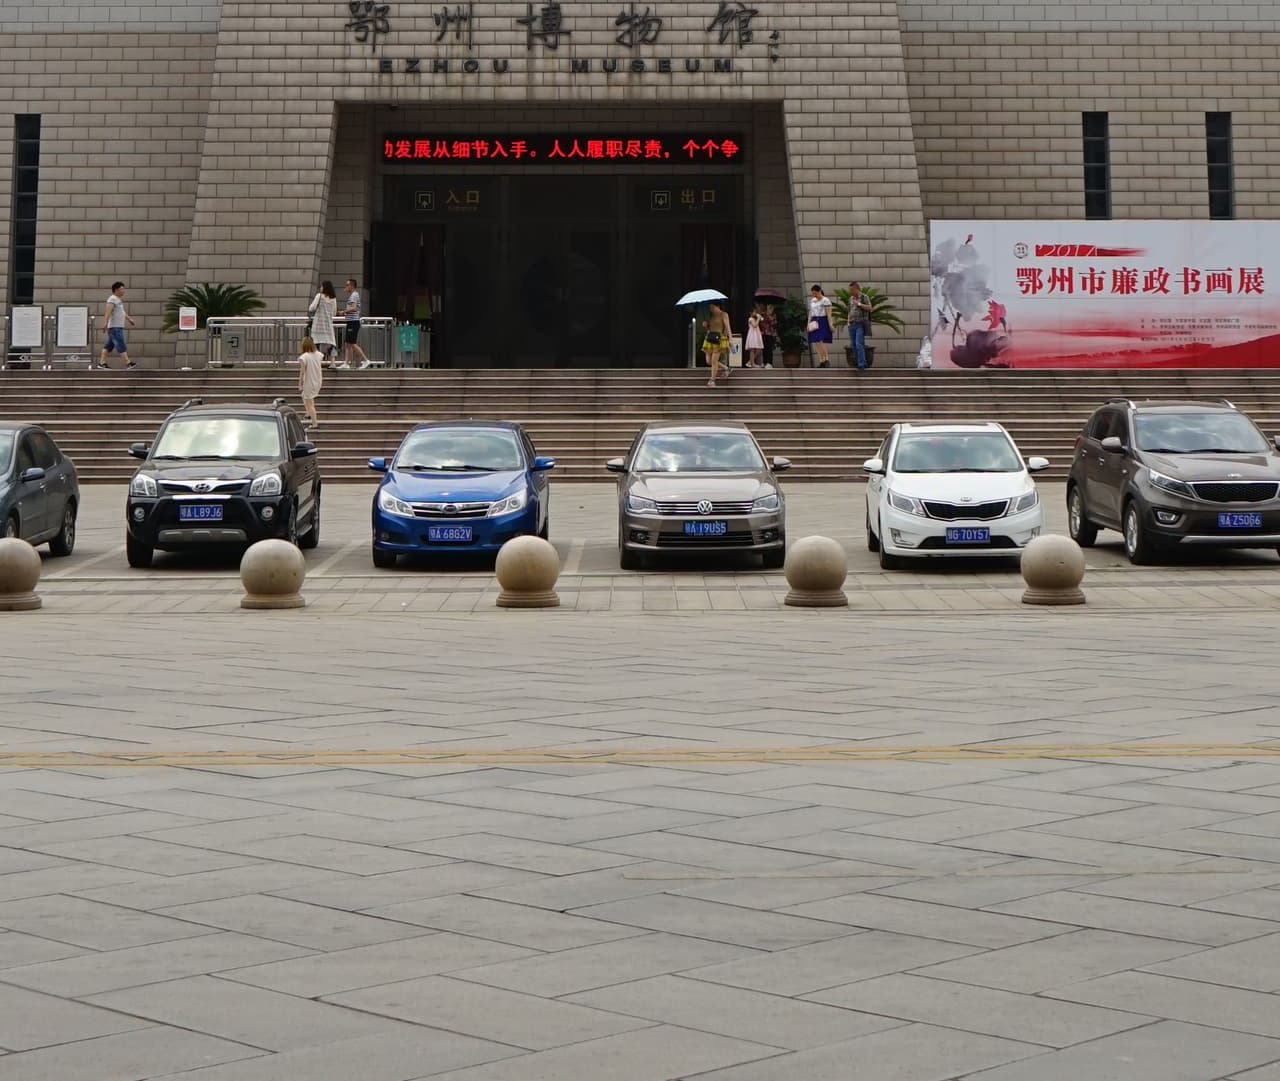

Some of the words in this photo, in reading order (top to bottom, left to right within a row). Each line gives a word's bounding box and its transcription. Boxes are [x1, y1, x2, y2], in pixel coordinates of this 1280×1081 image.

[379, 59, 509, 73] EZHOU
[571, 58, 733, 73] MUSEUM
[445, 189, 480, 204] 入口
[681, 188, 715, 203] 出口
[1015, 266, 1266, 295] 鄂州市廉政书画展
